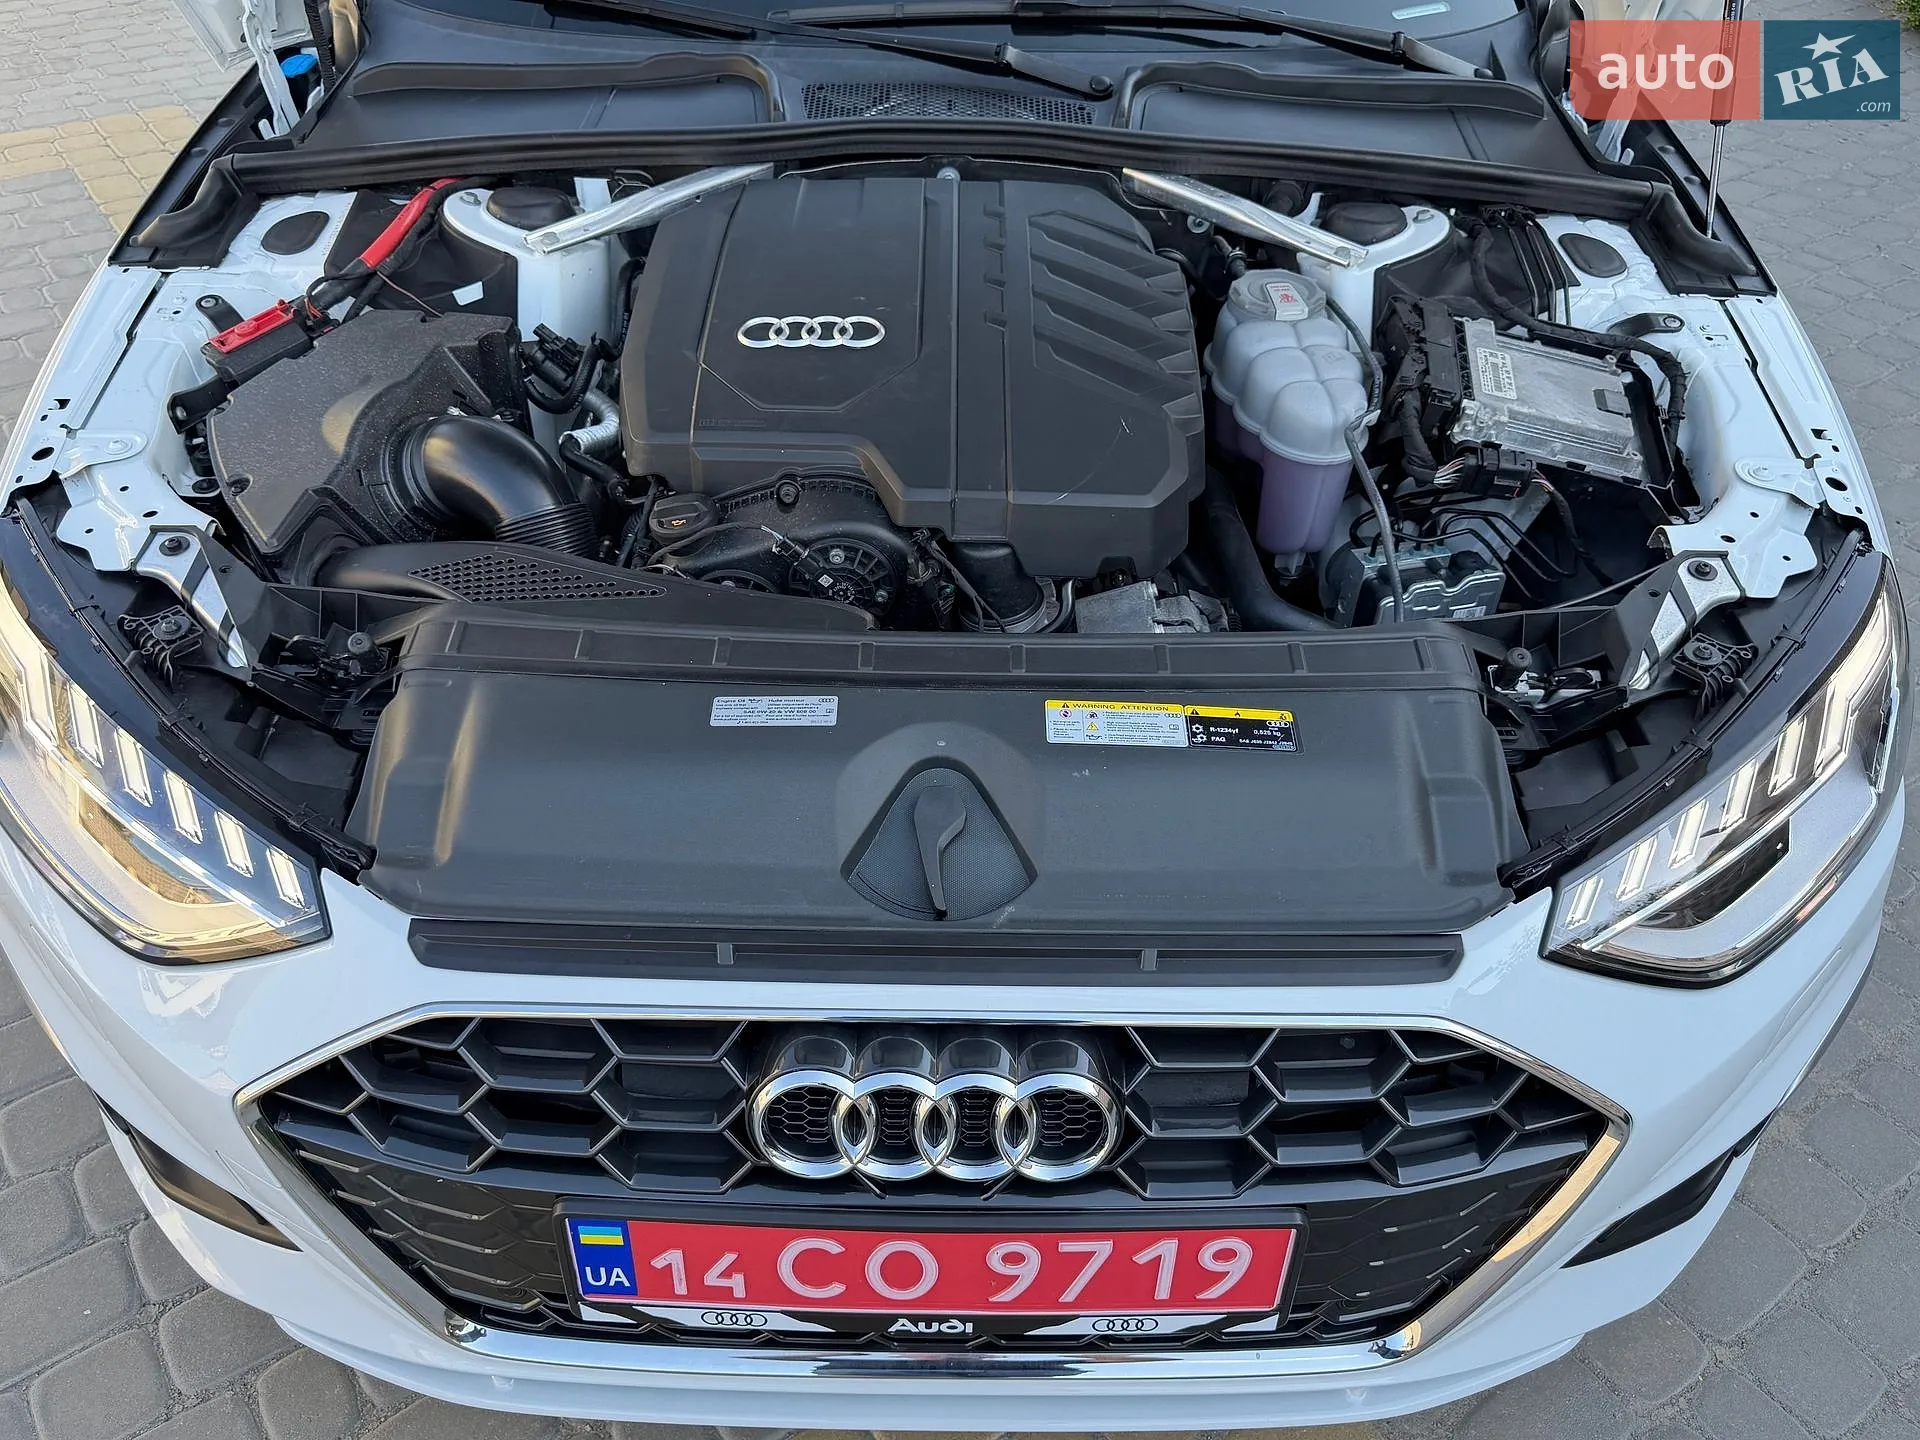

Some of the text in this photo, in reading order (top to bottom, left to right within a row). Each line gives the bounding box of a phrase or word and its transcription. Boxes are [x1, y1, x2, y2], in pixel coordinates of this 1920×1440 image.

[585, 1237, 1253, 1303] UA 14 CO 9719
[887, 1318, 973, 1333] Audi
